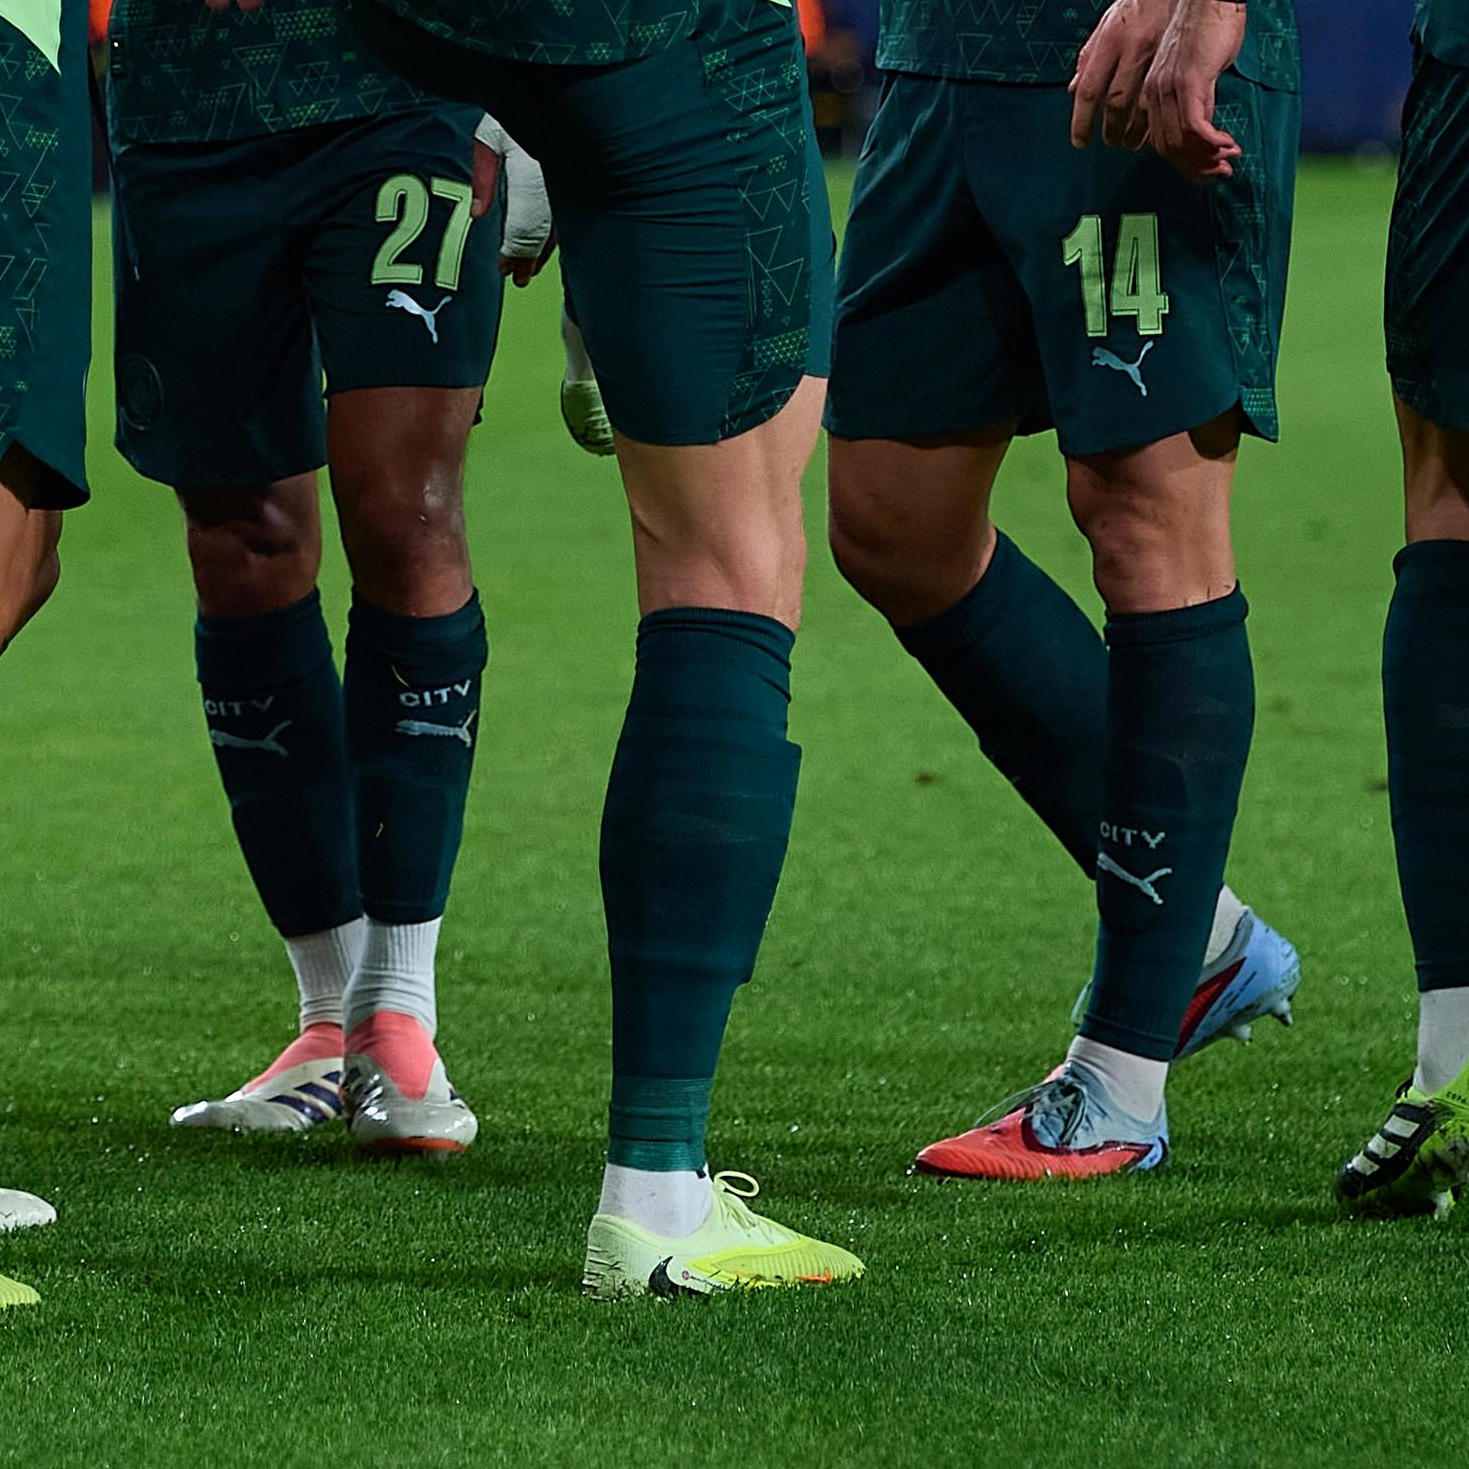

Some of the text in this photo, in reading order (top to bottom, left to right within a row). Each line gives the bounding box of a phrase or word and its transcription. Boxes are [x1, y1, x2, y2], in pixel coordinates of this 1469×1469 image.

[371, 175, 473, 292] 27
[1062, 212, 1169, 337] 14
[399, 680, 471, 708] CITY
[1100, 821, 1166, 849] CITY
